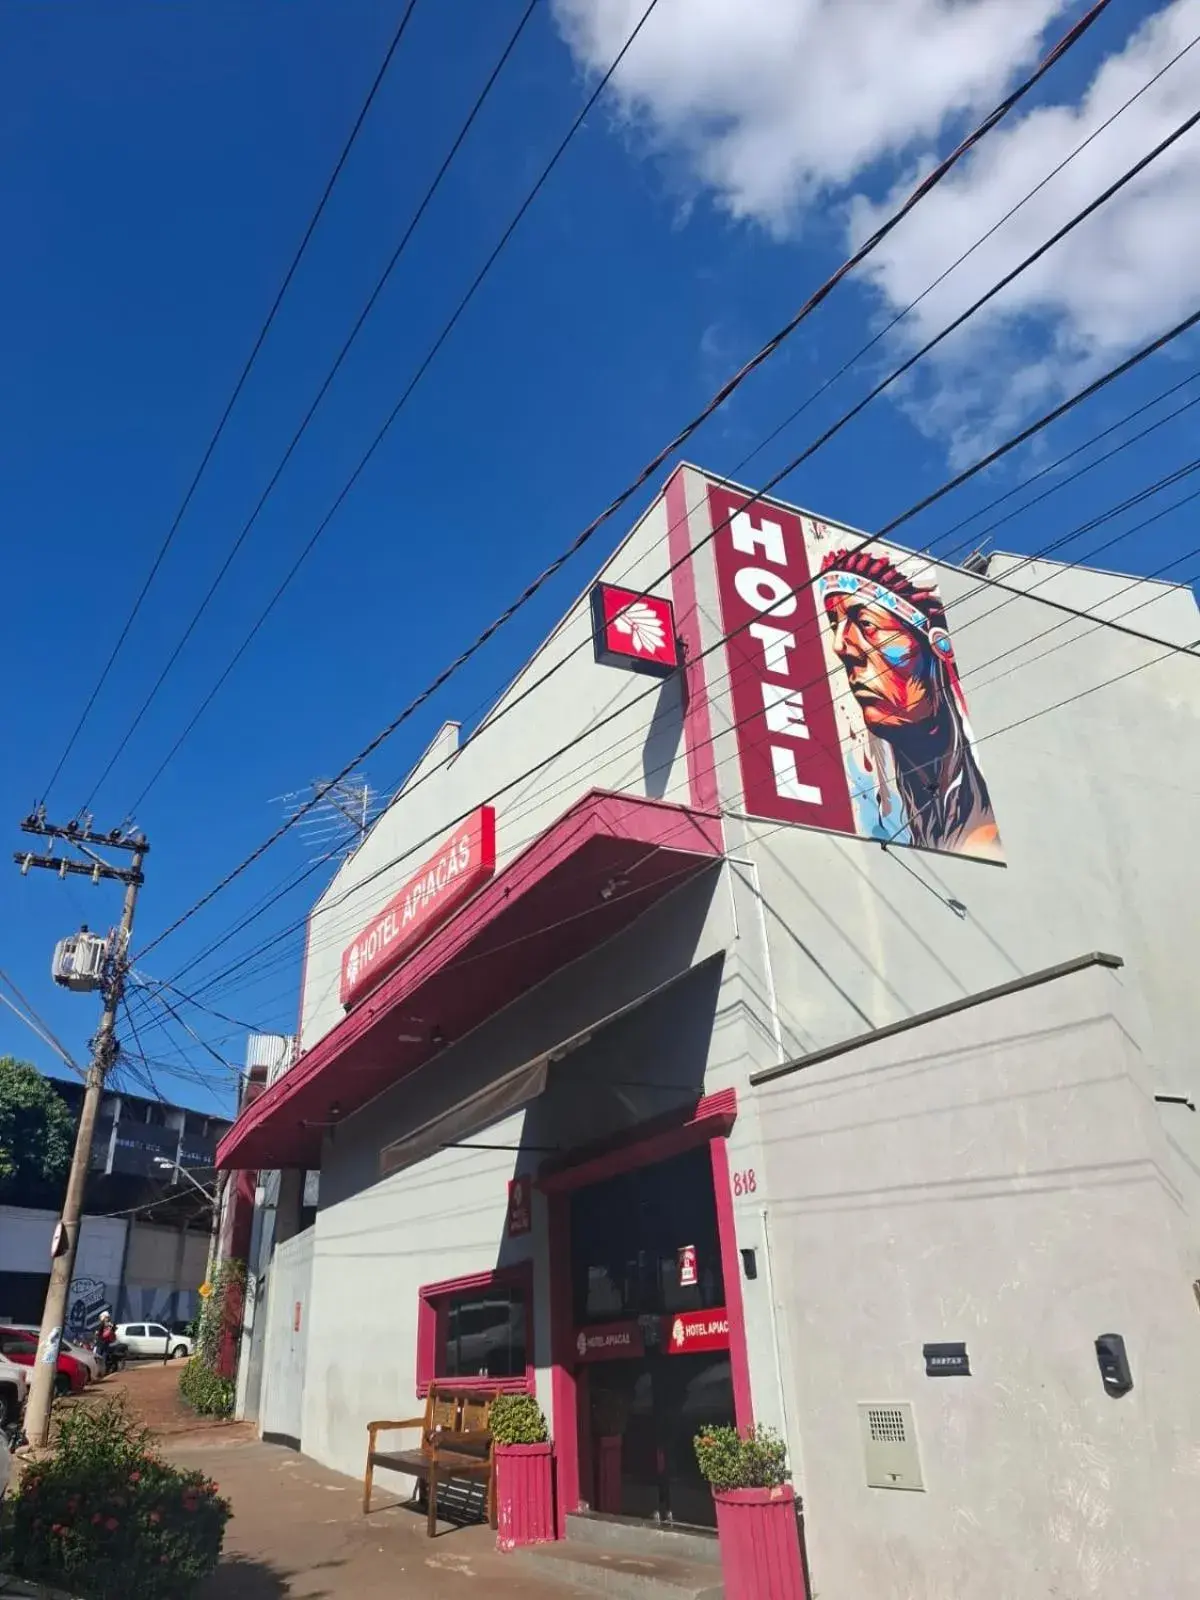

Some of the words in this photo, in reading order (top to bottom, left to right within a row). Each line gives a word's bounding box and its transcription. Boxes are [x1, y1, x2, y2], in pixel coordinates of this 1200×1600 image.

[728, 506, 823, 806] HOTEL
[360, 909, 399, 970] HOTEL
[734, 1169, 757, 1196] 818
[686, 1323, 708, 1336] HOTEL
